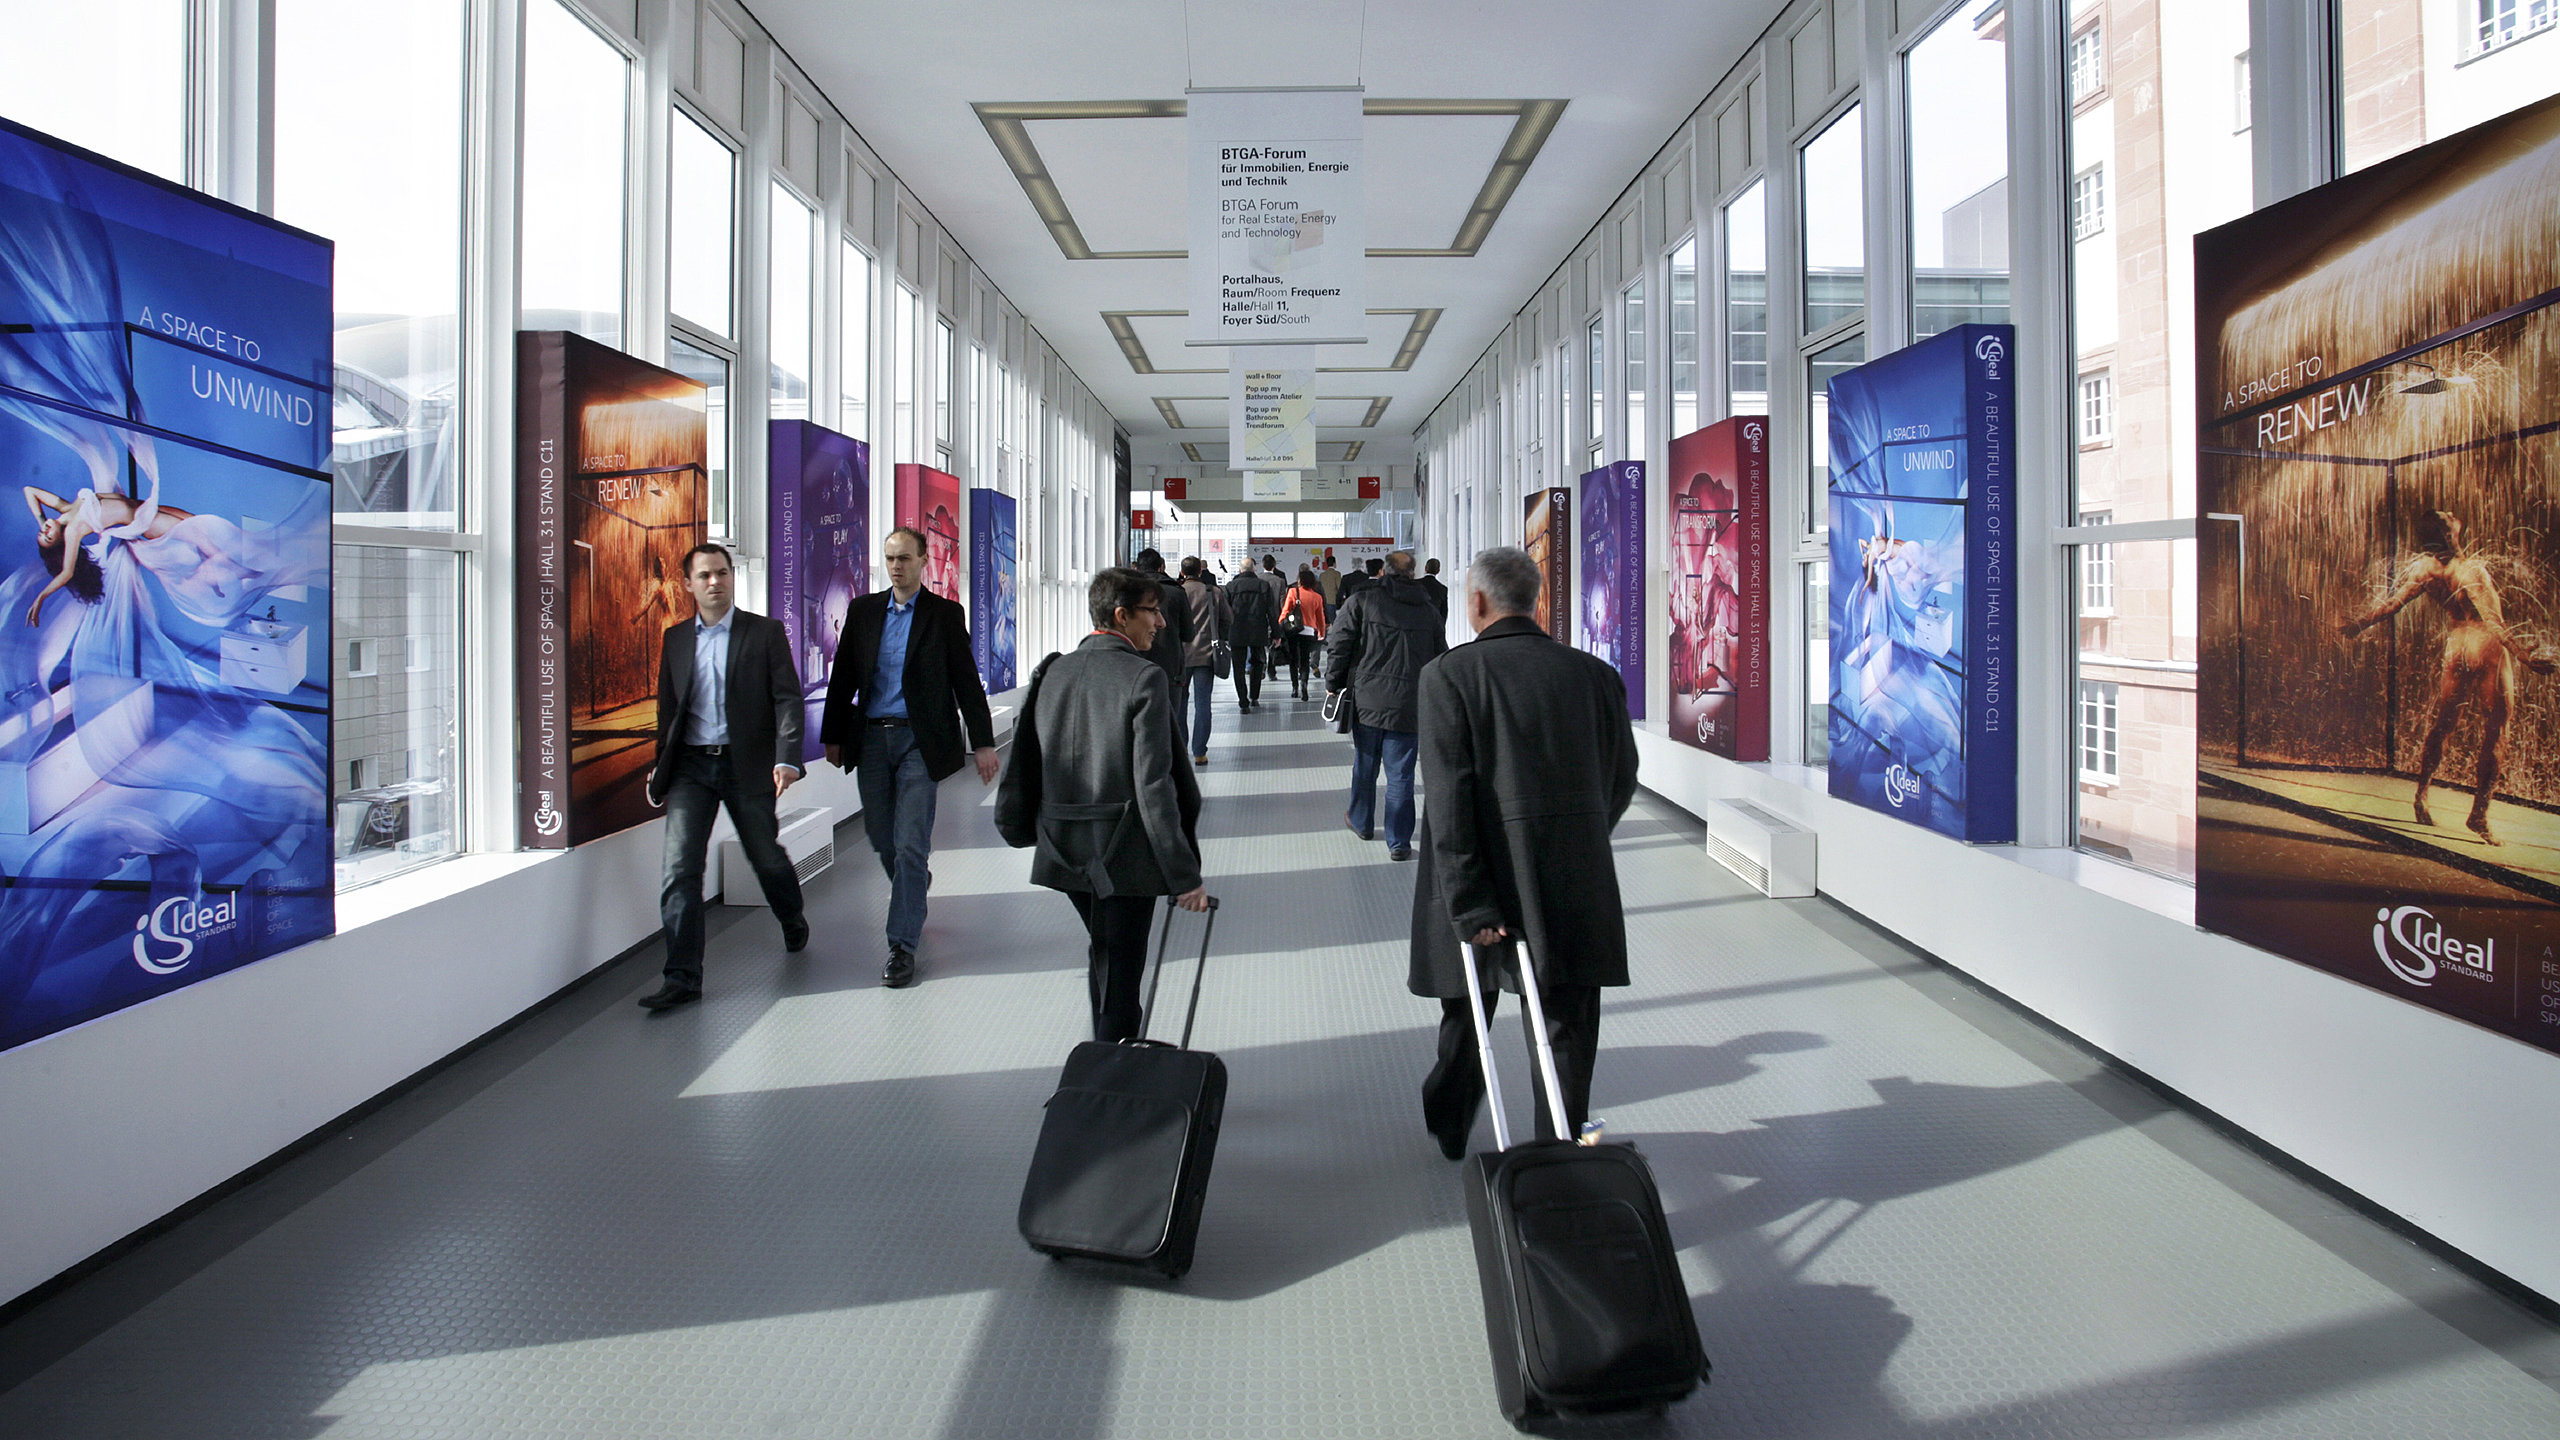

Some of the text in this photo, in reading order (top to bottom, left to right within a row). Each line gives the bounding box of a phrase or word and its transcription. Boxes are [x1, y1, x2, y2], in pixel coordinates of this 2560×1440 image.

[1221, 148, 1307, 160] BTGA-Forum
[1221, 162, 1349, 173] für Immobilien, Energie
[1221, 176, 1288, 187] und Technik
[1222, 199, 1299, 211] BTGA Forum
[1221, 213, 1337, 225] for Real Estate, Energy
[1221, 227, 1301, 239] and Technology
[1222, 274, 1284, 284] Portalhaus,
[1222, 287, 1341, 298] Raum/Room Frequenz
[1222, 301, 1289, 312] Halle/Hall 11,
[1222, 314, 1310, 326] Foyer Süd/South
[139, 306, 261, 361] A SPACE TO
[1988, 351, 2001, 380] Ideal
[2223, 356, 2322, 411] A SPACE TO
[192, 365, 313, 426] UNWIND
[1986, 391, 1998, 402] A
[2258, 377, 2371, 448] RENEW
[1886, 424, 1930, 441] A SPACE TO
[1986, 405, 2000, 481] BEAUTIFUL
[583, 454, 625, 470] A SPACE TO
[1903, 449, 1955, 472] UNWIND
[599, 478, 642, 502] RENEW
[784, 490, 793, 508] C11
[1750, 469, 1760, 520] BEAUTIFUL
[1986, 486, 2000, 512] USE
[784, 511, 793, 542] STAND
[1682, 514, 1717, 529] TRANSFORM
[1751, 522, 1760, 541] USE
[1987, 516, 2000, 537] OF
[833, 528, 848, 546] PLAY
[1212, 541, 1220, 549] 4
[1751, 542, 1760, 558] OF
[784, 560, 793, 584] HALL
[1751, 559, 1760, 588] SPACE
[1987, 541, 2000, 584] SPACE
[540, 439, 555, 780] A BEAUTIFUL USE OF SPACE HALL 3.1 STAND C11
[784, 589, 793, 619] SPACE
[1750, 595, 1760, 618] HALL
[1987, 594, 2000, 629] HALL
[1750, 637, 1760, 669] STAND
[1750, 671, 1760, 688] C11
[1986, 656, 2000, 704] STAND
[1985, 708, 1999, 733] C11
[173, 891, 236, 934] Ideal
[195, 921, 237, 940] STANDARD
[267, 919, 293, 935] SPACE
[2415, 917, 2494, 972] Ideal
[2543, 945, 2553, 958] A
[2440, 959, 2494, 983] STANDARD
